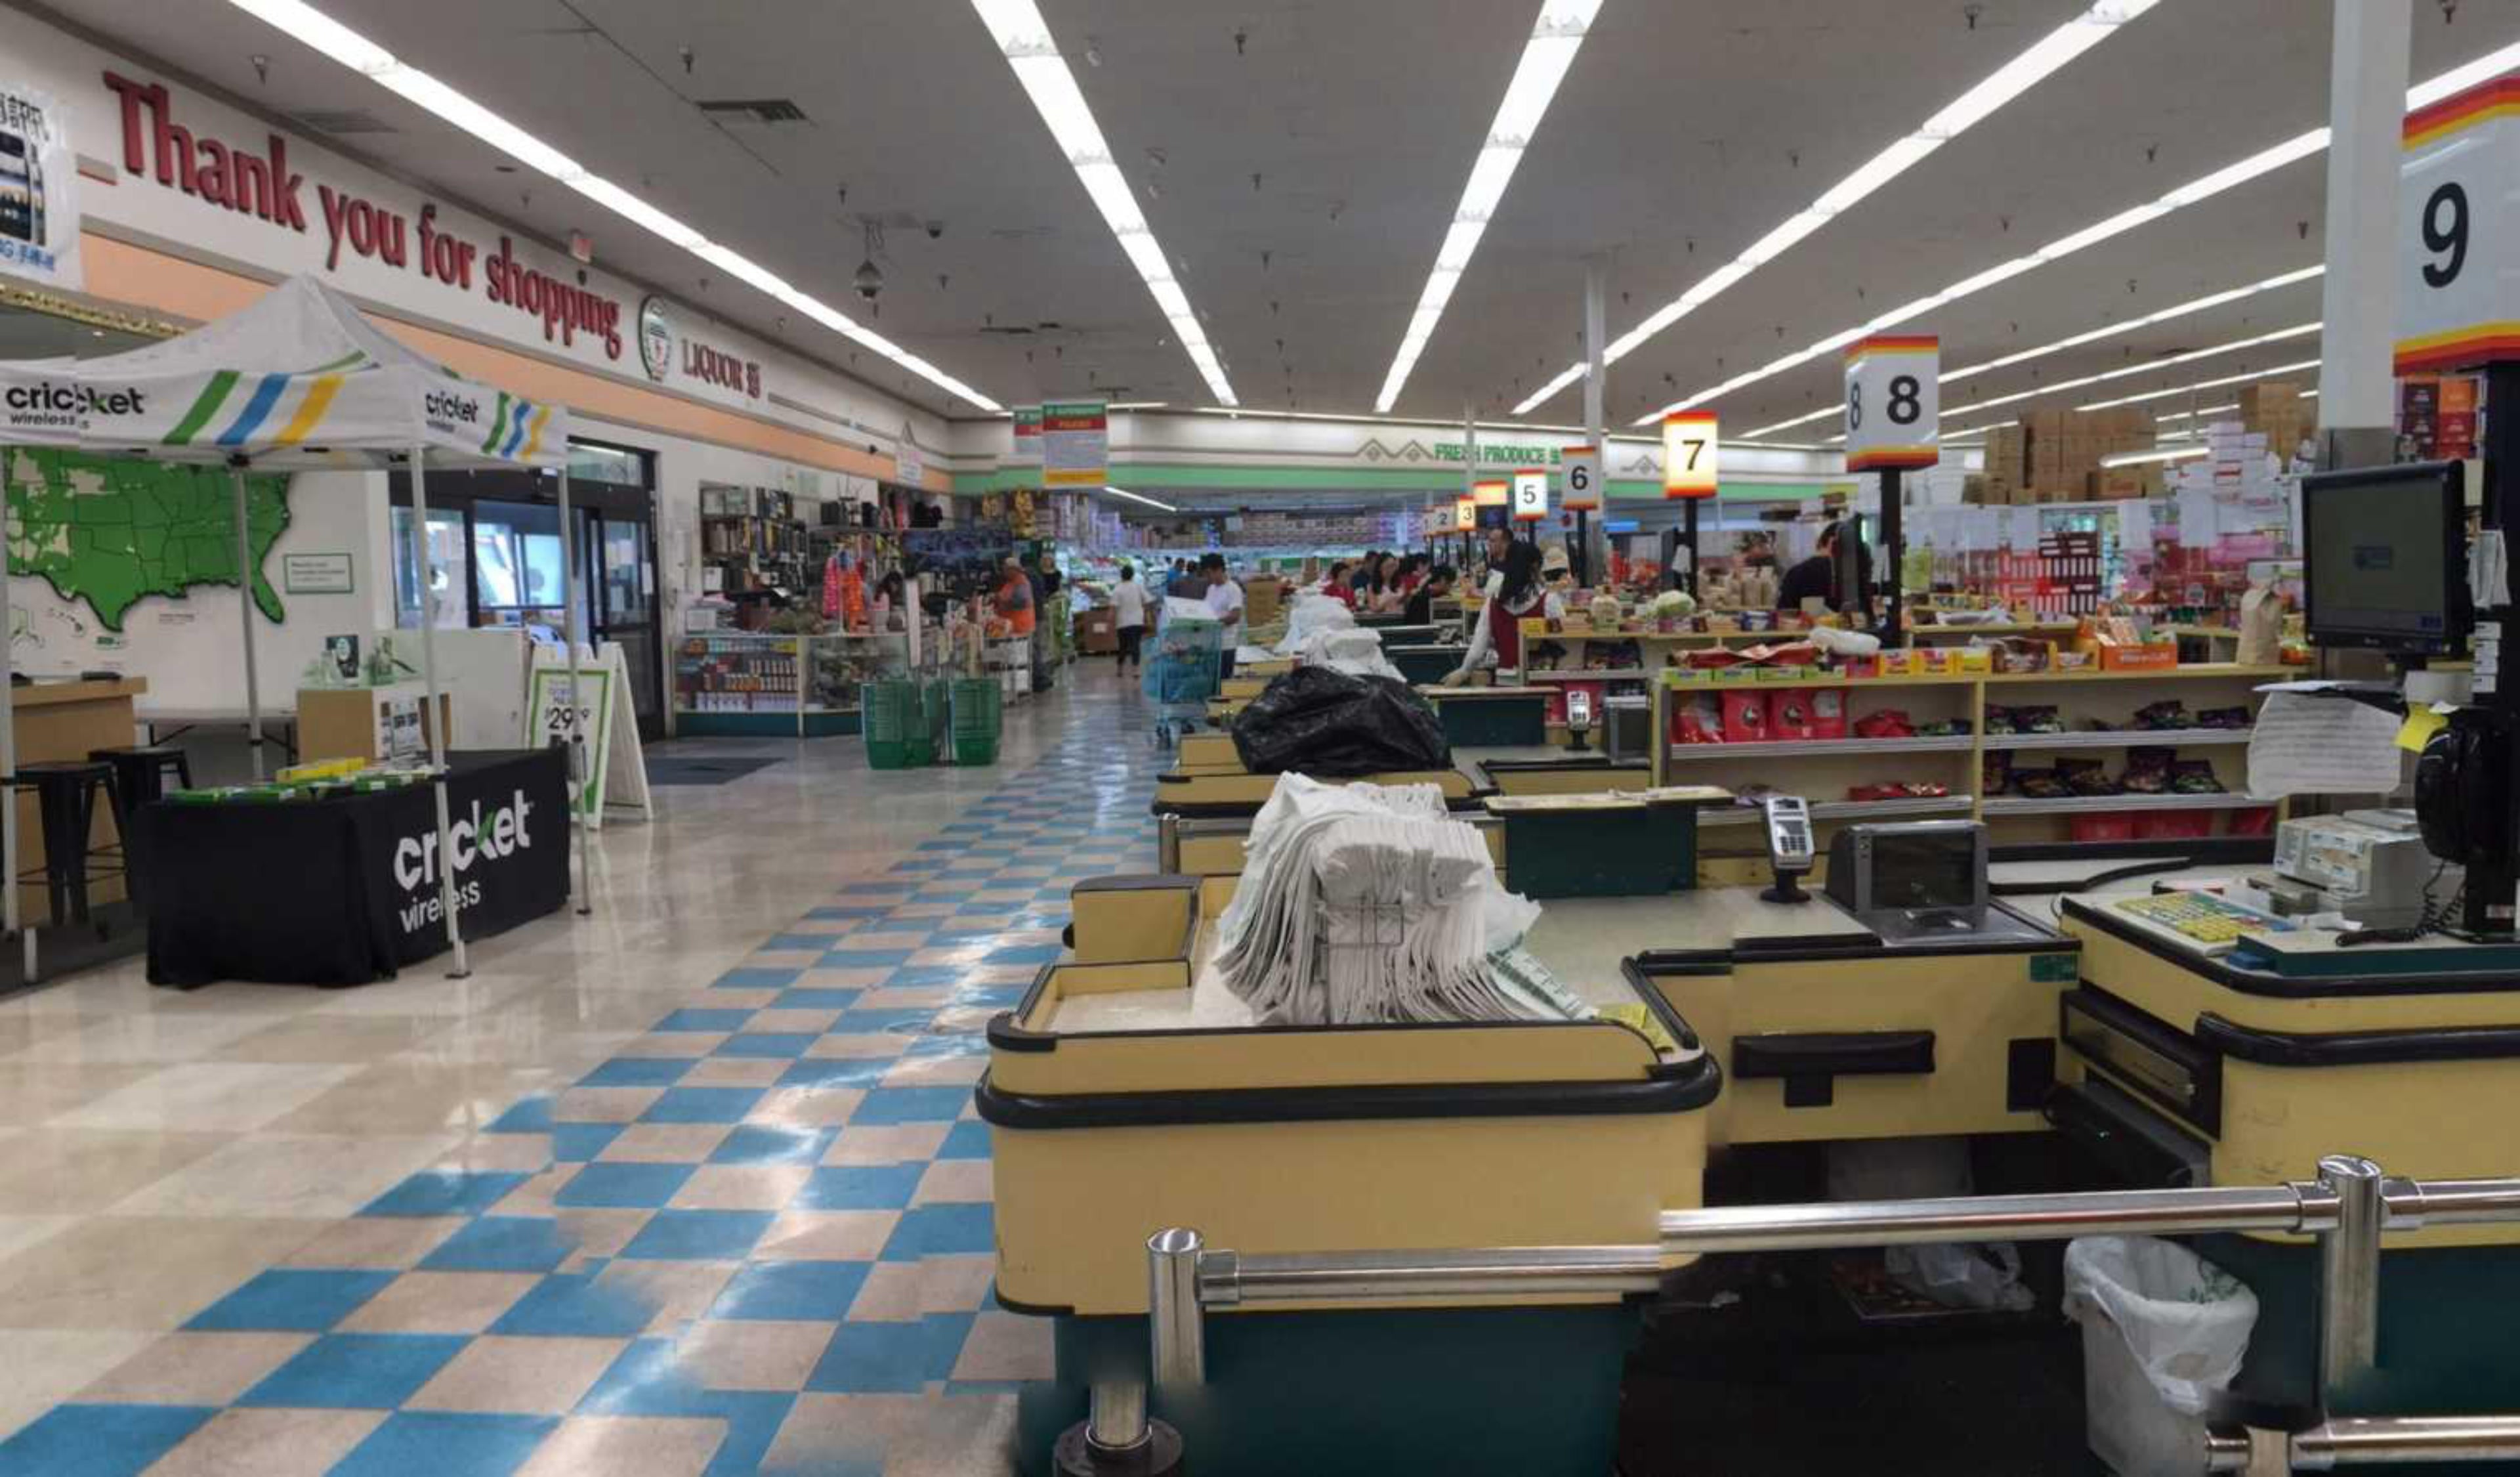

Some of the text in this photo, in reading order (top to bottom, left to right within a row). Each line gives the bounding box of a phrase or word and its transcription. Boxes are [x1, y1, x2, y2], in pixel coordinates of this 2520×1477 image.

[103, 70, 306, 233] Thank
[318, 184, 407, 272] you
[417, 203, 476, 290] for
[486, 236, 621, 360] shopping
[2421, 182, 2469, 288] 9
[682, 338, 744, 392] LIQUOR
[1851, 382, 1861, 431] 8
[1887, 374, 1920, 425] 8
[1484, 446, 1545, 463] PRODUCE
[1683, 439, 1705, 471] 7
[1523, 485, 1536, 504] 5
[1571, 466, 1588, 490] 6
[1438, 512, 1448, 525] 2
[1463, 507, 1473, 520] 3
[394, 790, 531, 890] crcket
